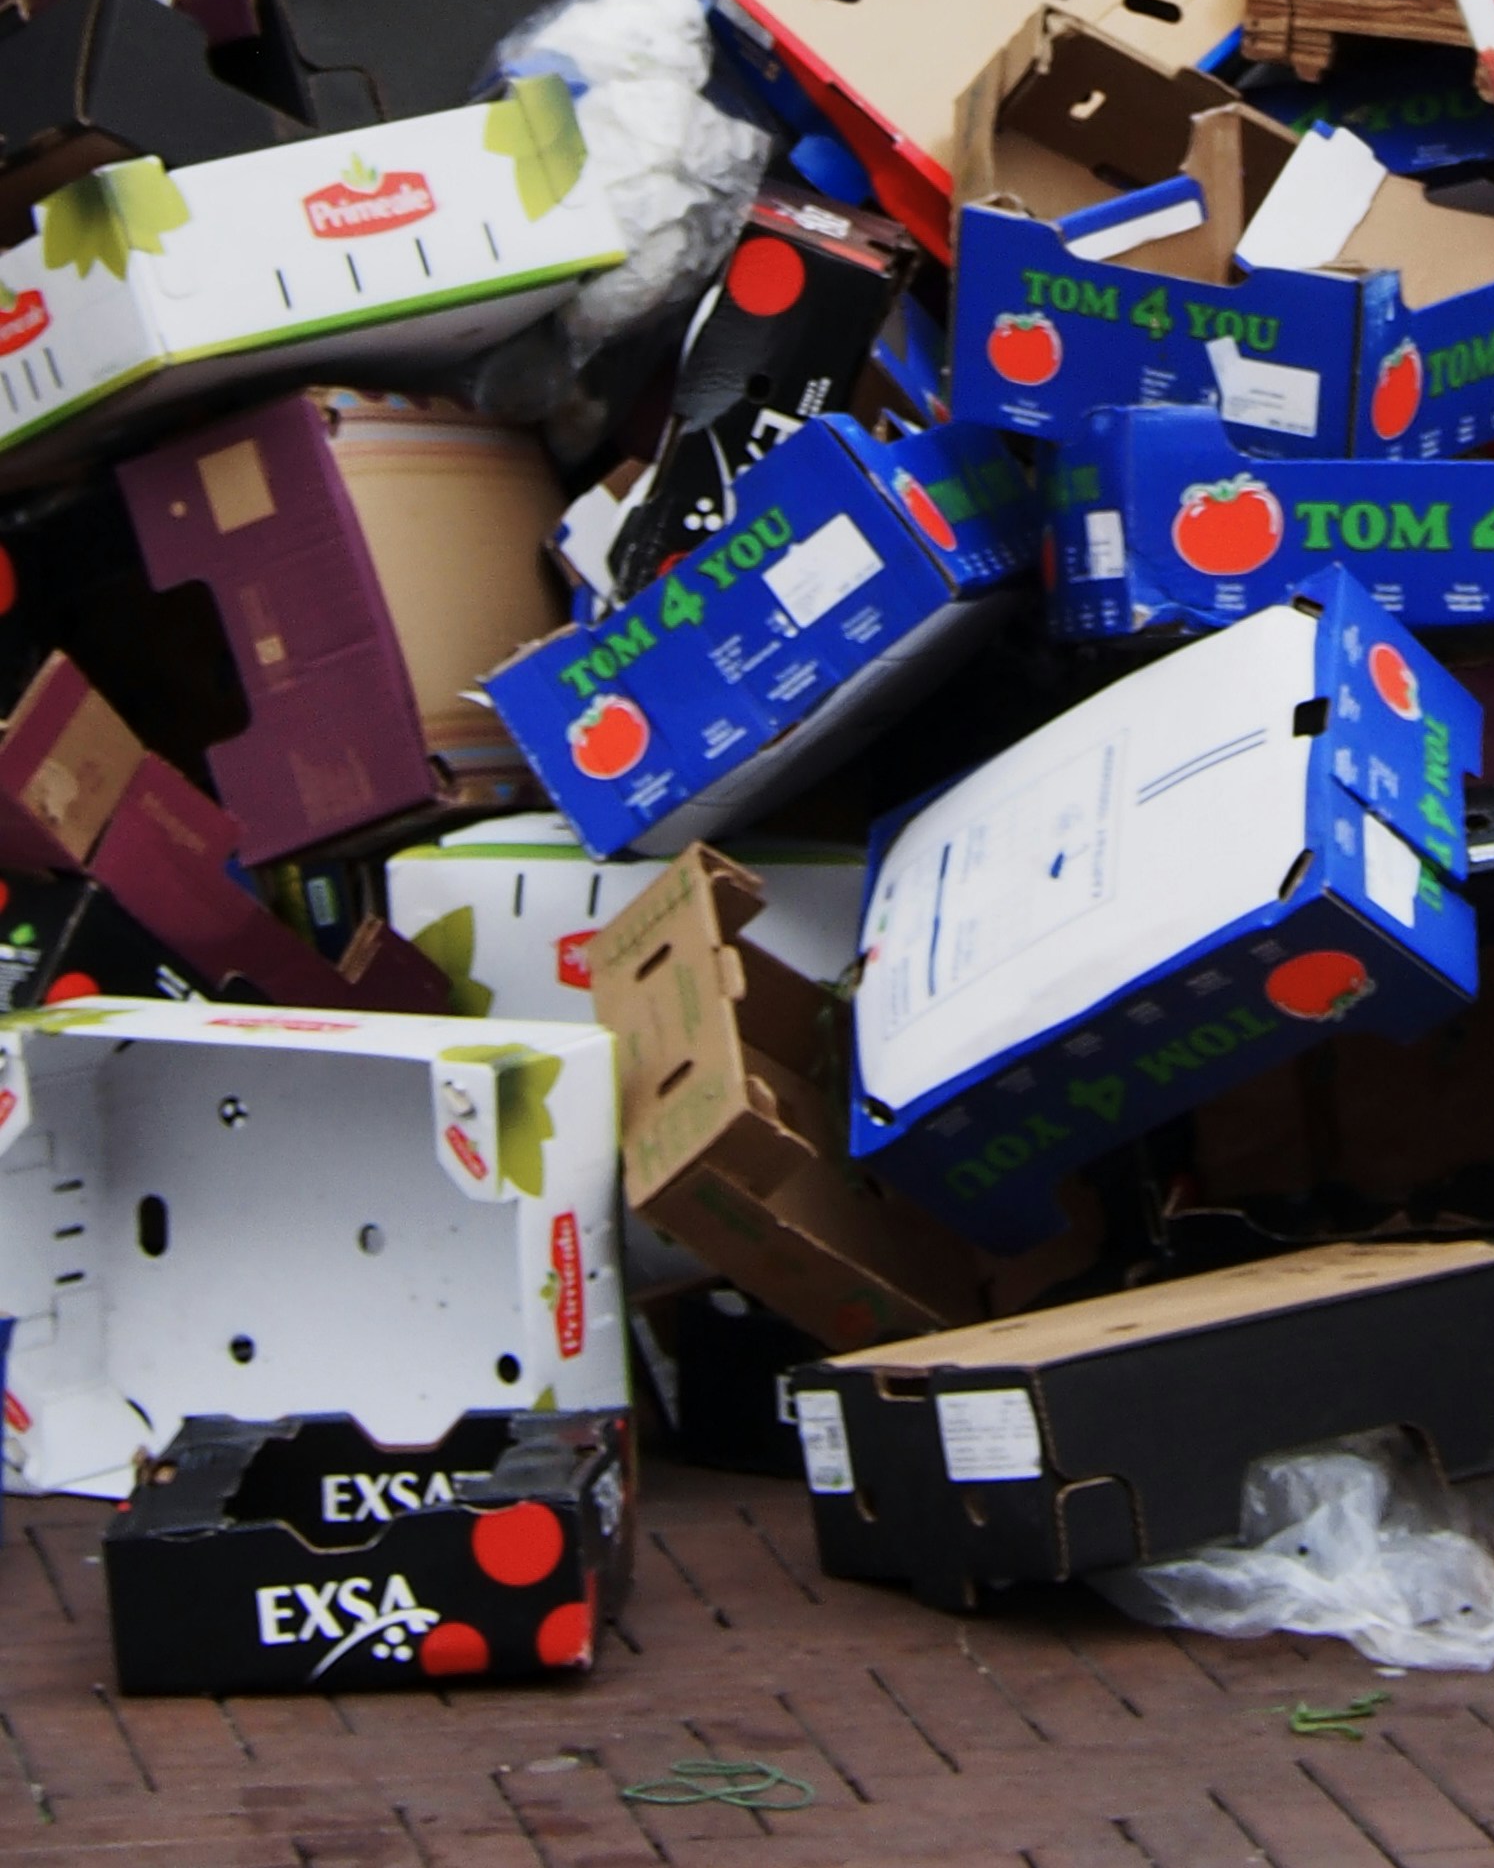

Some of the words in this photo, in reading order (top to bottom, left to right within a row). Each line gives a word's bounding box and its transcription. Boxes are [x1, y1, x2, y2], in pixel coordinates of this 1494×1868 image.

[1022, 268, 1120, 322] TOM
[1129, 286, 1174, 340] 4
[1184, 302, 1281, 352] YOU
[1295, 502, 1452, 552] TOM
[559, 615, 658, 700] TOM
[659, 573, 705, 631] 4
[696, 506, 794, 592] YOU
[1422, 712, 1451, 799] TOM
[1417, 792, 1459, 838] 4
[1132, 1004, 1282, 1087] TOM
[1065, 1071, 1129, 1125] 4
[944, 1112, 1074, 1201] YOU
[321, 1470, 454, 1523] EXSA
[254, 1573, 432, 1647] EXSA
